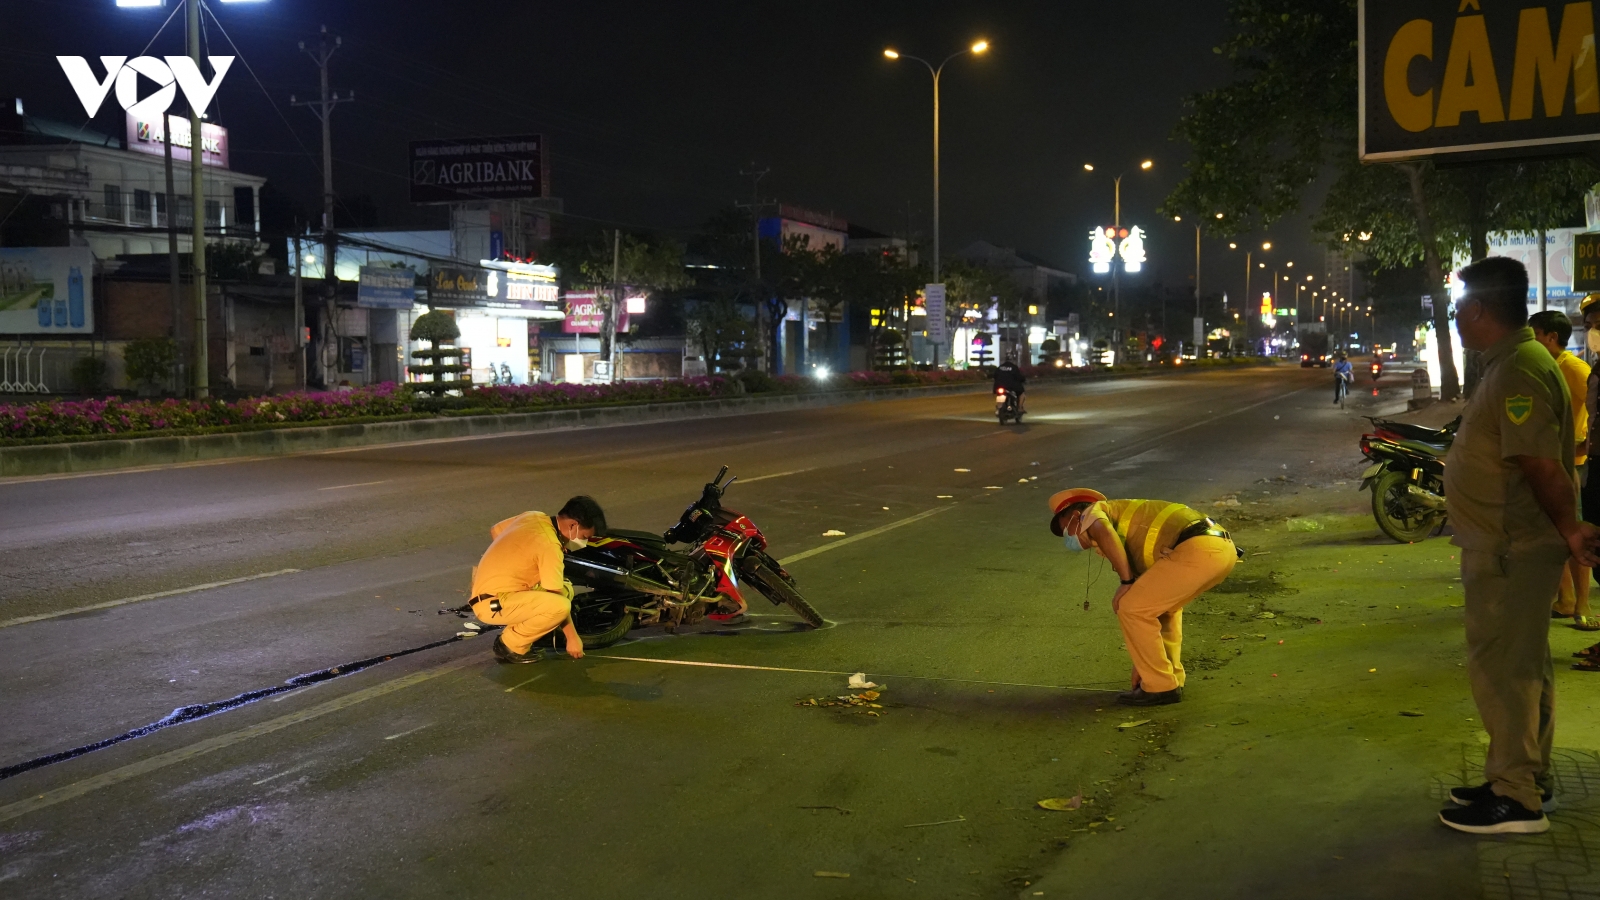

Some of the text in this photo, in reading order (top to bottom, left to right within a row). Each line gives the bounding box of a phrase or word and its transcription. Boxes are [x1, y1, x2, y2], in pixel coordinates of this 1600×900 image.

[152, 126, 221, 154] ARIBNK
[437, 159, 535, 184] AGRIBANK
[1526, 236, 1556, 245] PHNG
[1582, 265, 1597, 280] XE
